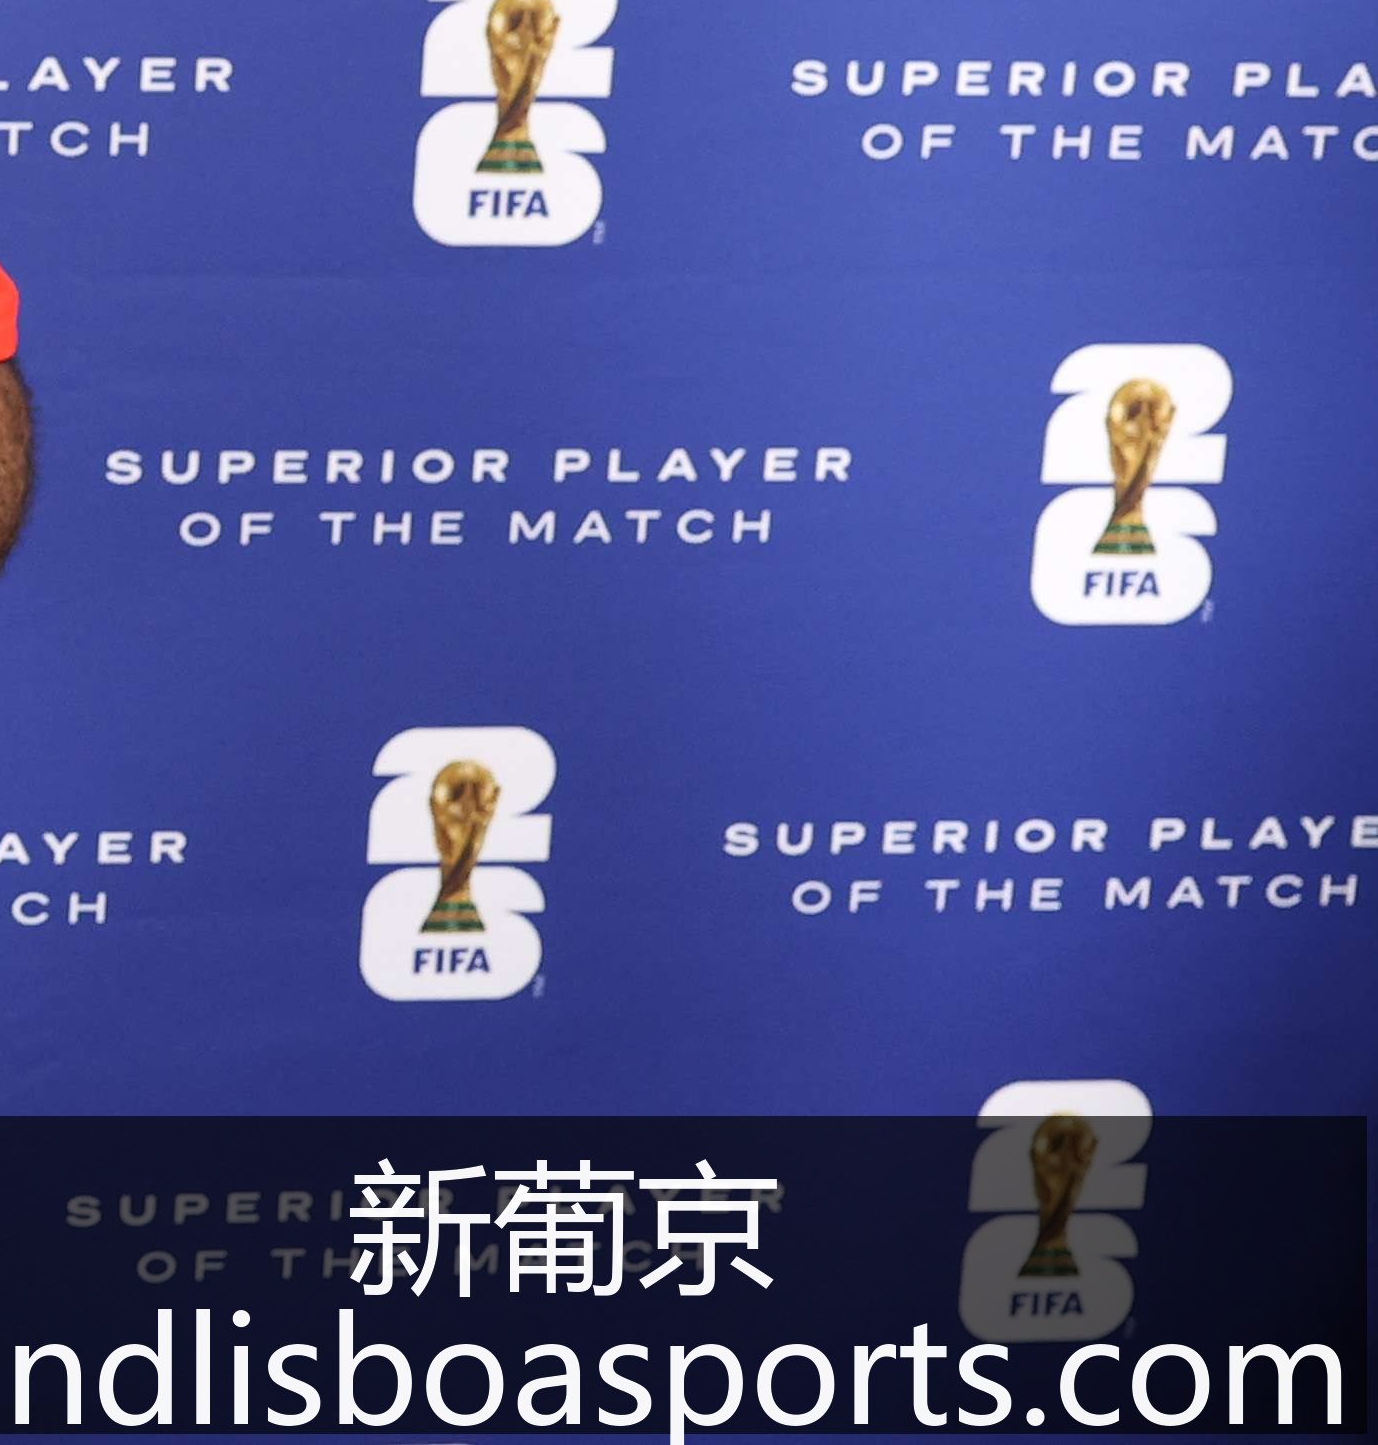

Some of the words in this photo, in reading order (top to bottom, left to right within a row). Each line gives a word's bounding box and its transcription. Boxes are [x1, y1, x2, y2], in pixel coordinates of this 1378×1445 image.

[792, 60, 1189, 96] SUPERIOR
[1233, 62, 1377, 98] PLA
[862, 124, 955, 159] OF
[1001, 125, 1142, 159] THE
[1187, 125, 1378, 161] MATC
[468, 189, 549, 218] FIFA
[106, 450, 508, 484] SUPERIOR
[554, 448, 851, 481] PLAYER
[180, 513, 273, 546] OF
[320, 512, 463, 544] THE
[510, 510, 770, 543] MATCH
[1083, 569, 1159, 598] FIFA
[724, 819, 1107, 855] SUPERIOR
[1150, 816, 1378, 851] PLAYE
[793, 881, 881, 914] OF
[926, 879, 1062, 911] THE
[1106, 874, 1357, 909] MATCH
[413, 947, 491, 974] FIFA
[137, 1250, 227, 1285] OF
[1008, 1291, 1085, 1319] FIFA
